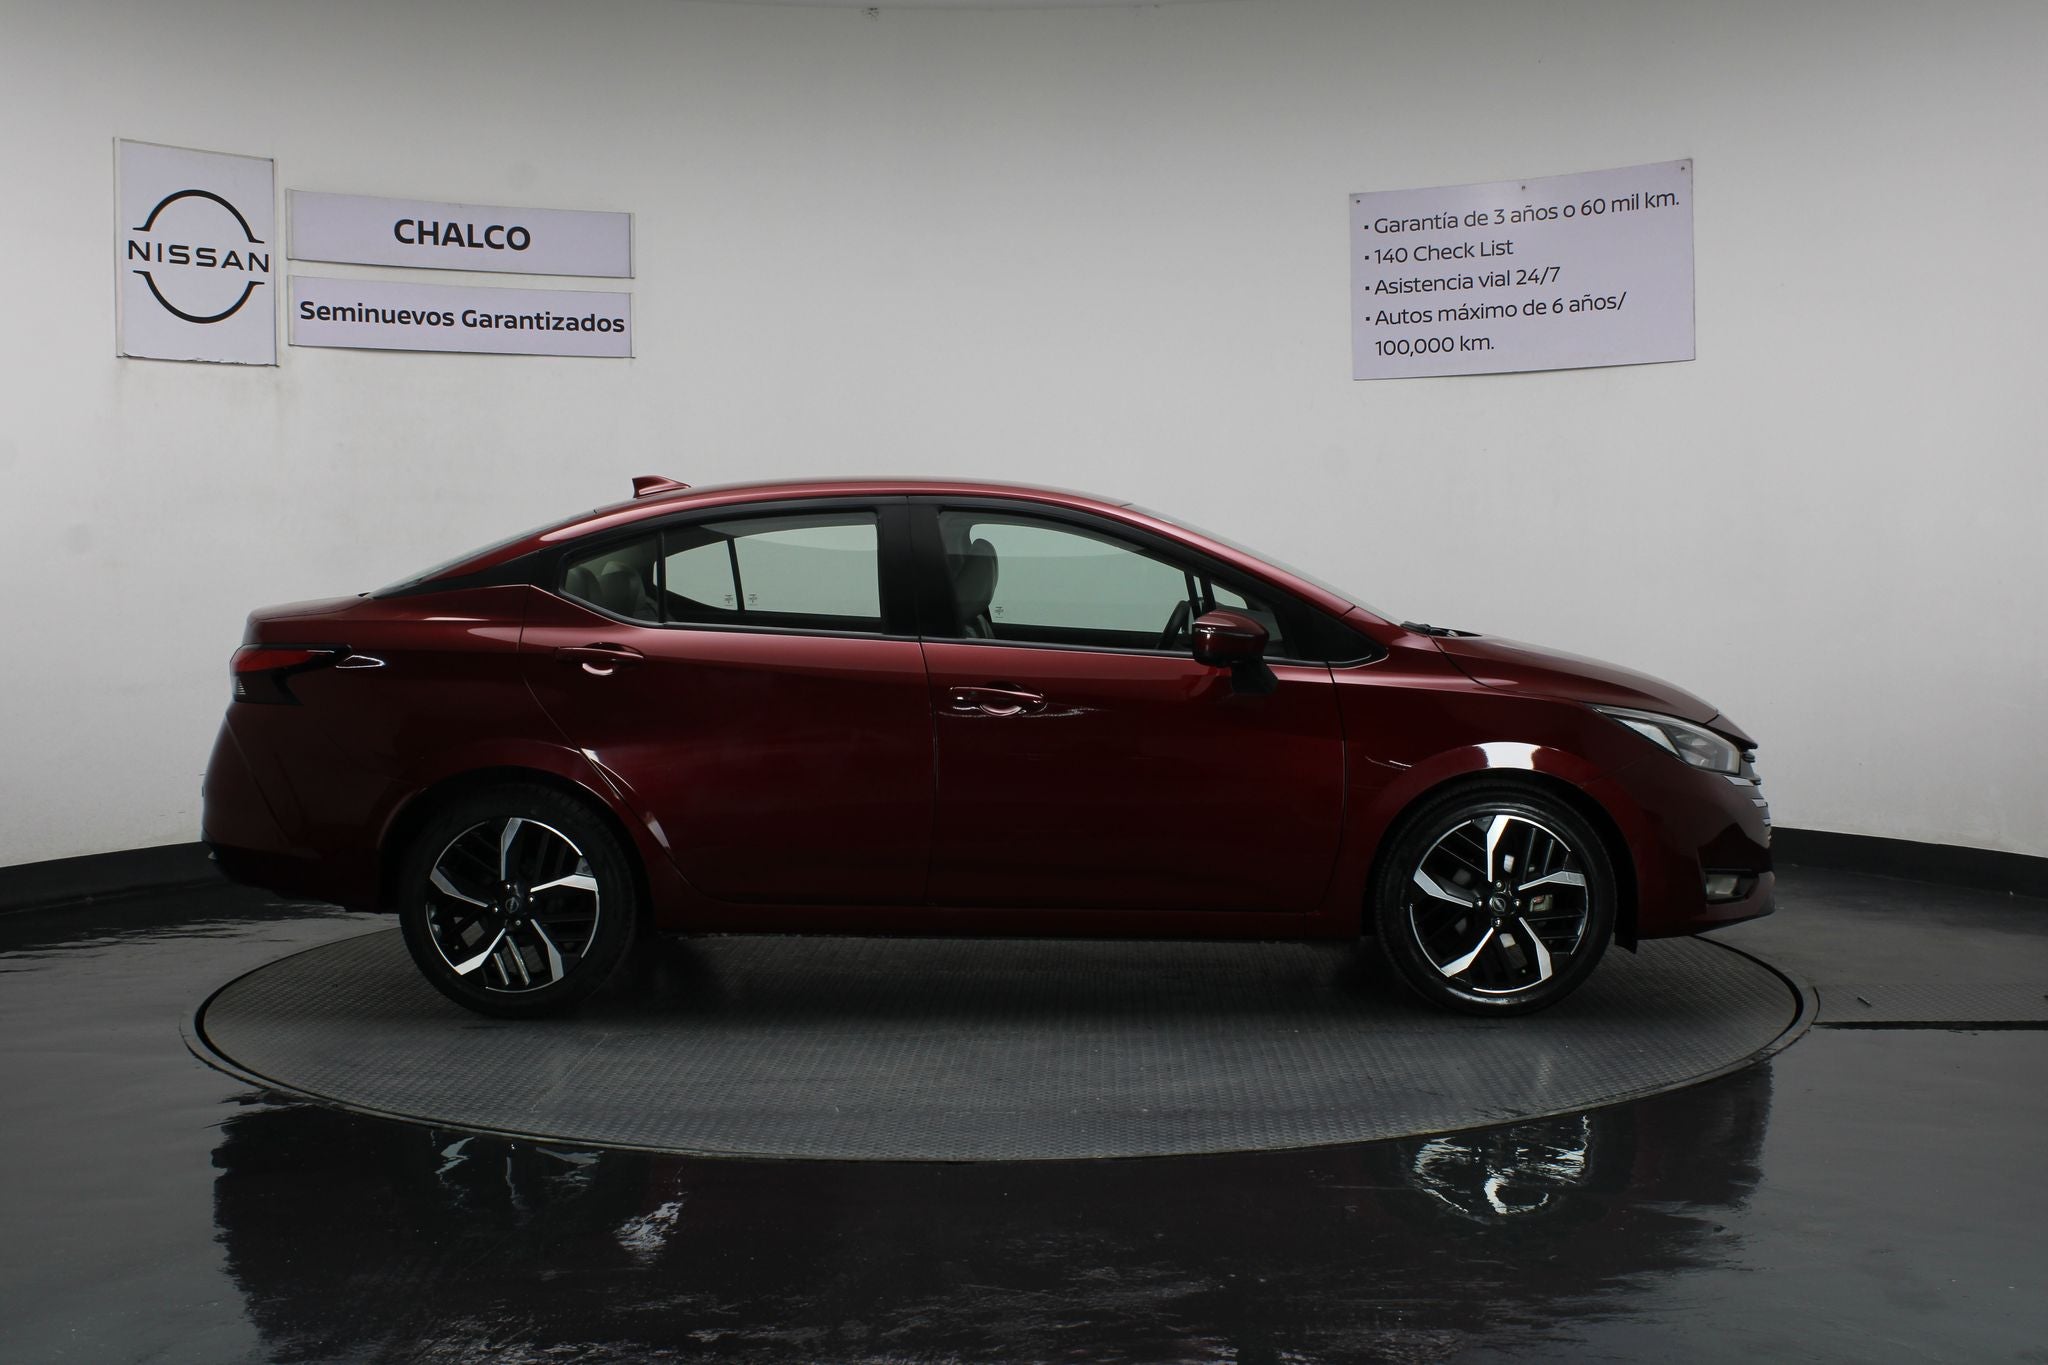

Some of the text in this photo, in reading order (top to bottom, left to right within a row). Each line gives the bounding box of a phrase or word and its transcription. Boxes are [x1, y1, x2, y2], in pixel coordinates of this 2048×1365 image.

[1374, 192, 1680, 233] Garantía de 3 años o 60 mil km.
[394, 219, 530, 251] CHALCO
[128, 240, 270, 272] NISSAN
[1374, 240, 1514, 264] 140 Check List
[1375, 266, 1561, 295] Asistencia vial 24/7
[300, 301, 625, 332] Seminuevos Garantizados
[1375, 291, 1627, 325] Autos máximo de 6 años/
[1375, 336, 1495, 357] 100,000 km.
